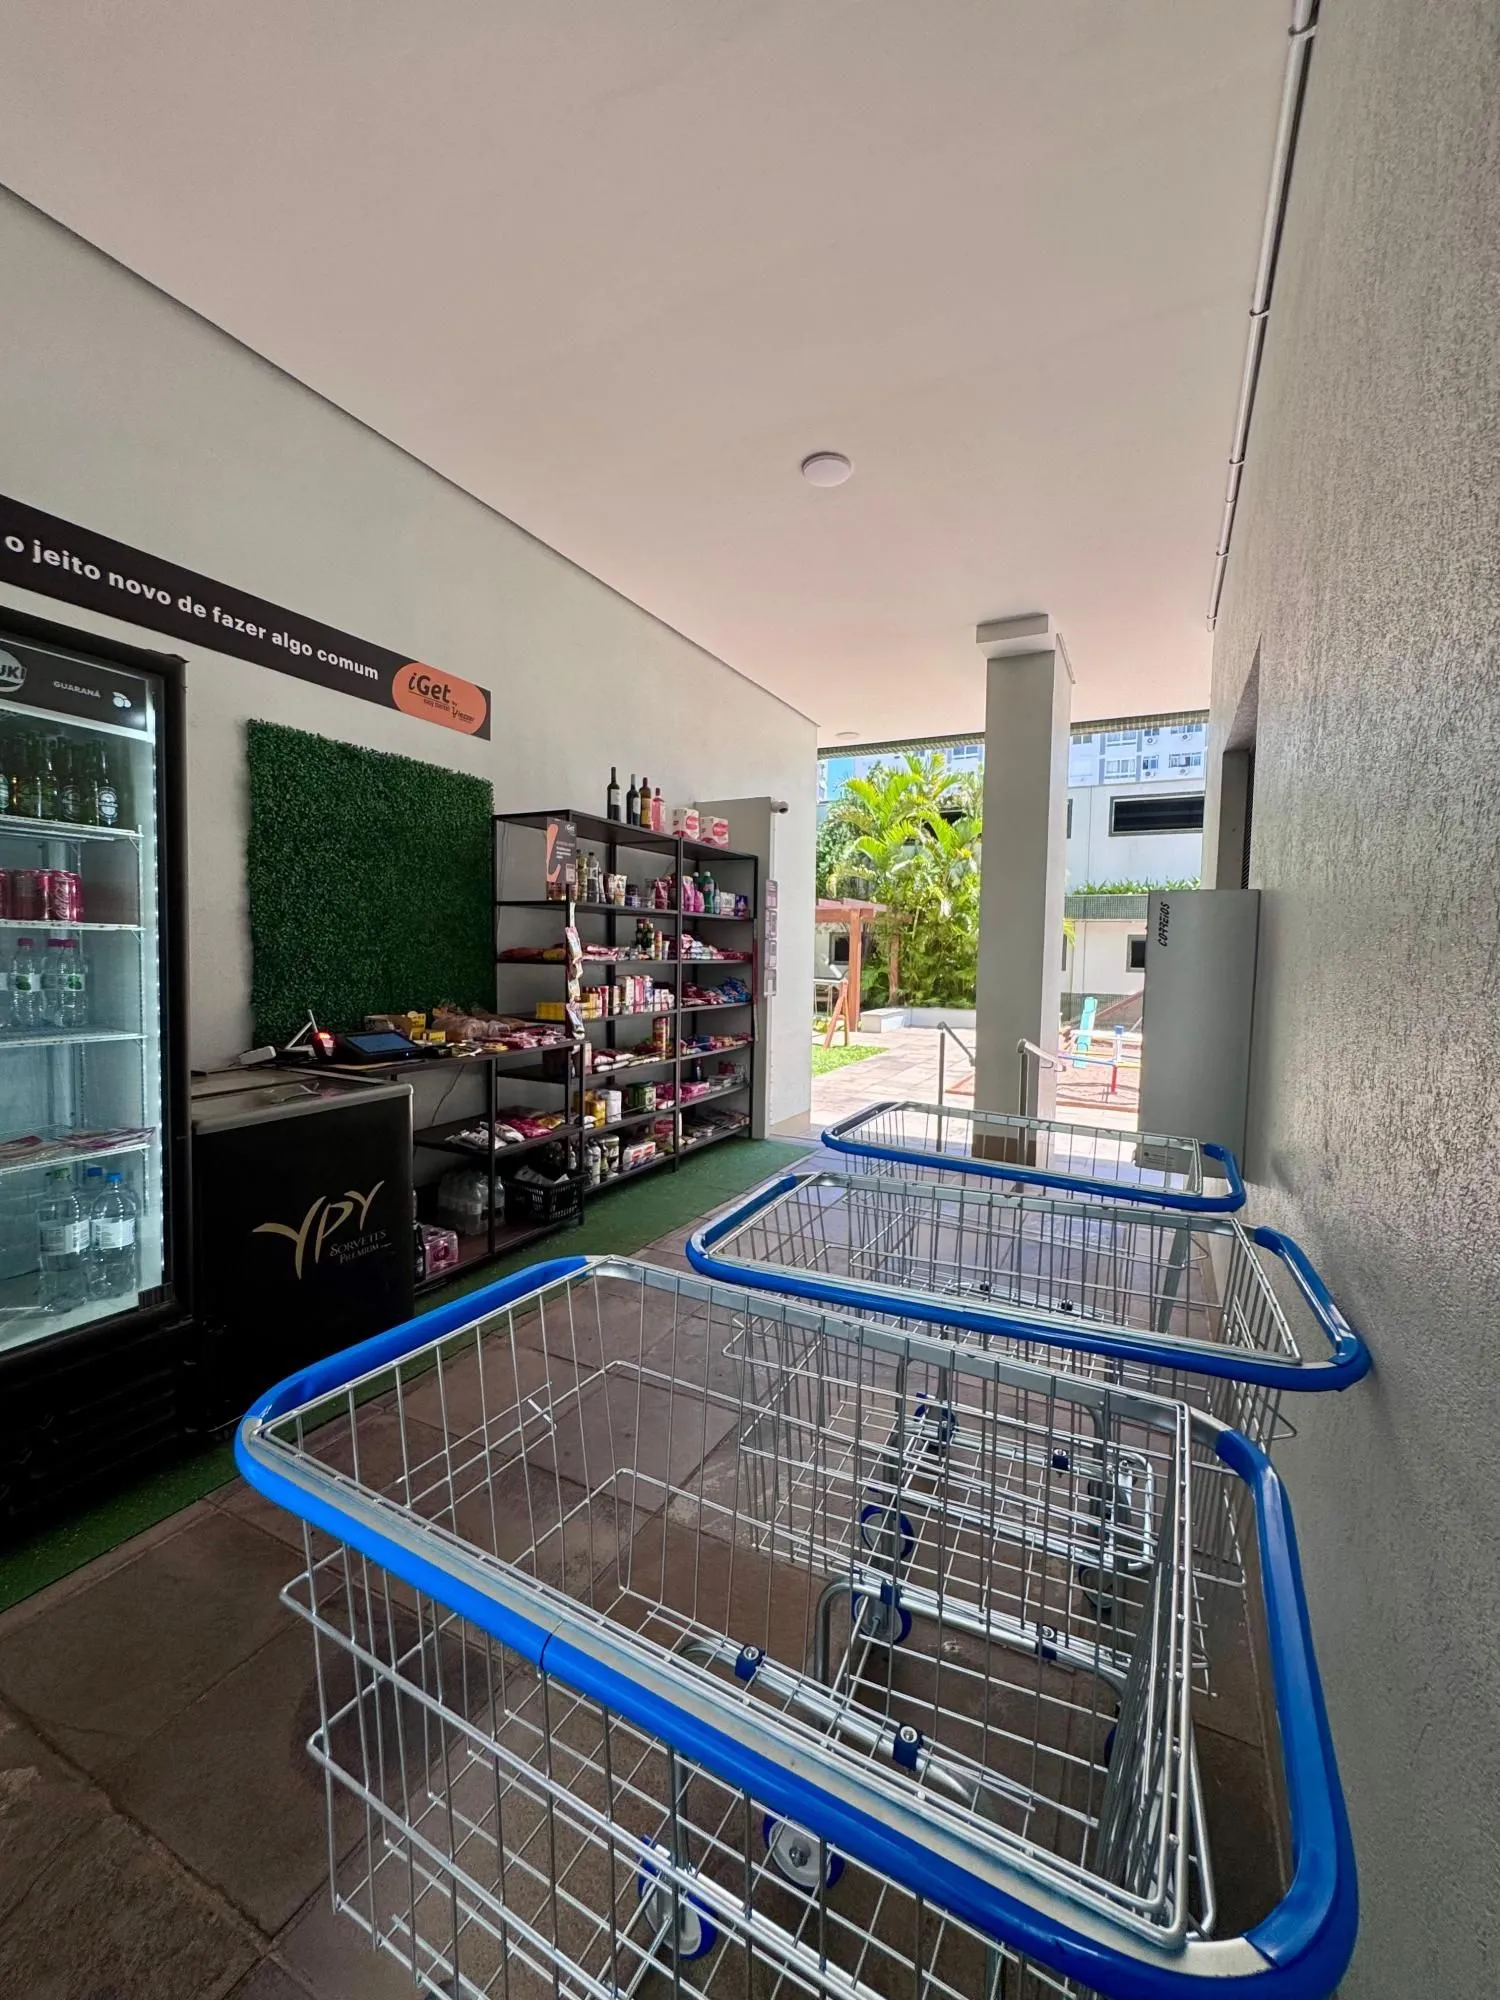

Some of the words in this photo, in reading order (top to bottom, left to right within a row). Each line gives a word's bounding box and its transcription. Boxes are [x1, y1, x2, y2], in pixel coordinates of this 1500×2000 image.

[5, 535, 25, 553] o
[32, 539, 101, 581] jeito
[108, 571, 172, 606] novo
[177, 595, 207, 618] de
[212, 606, 267, 640] fazer
[271, 632, 313, 656] algo
[317, 648, 379, 681] comum
[408, 672, 452, 704] iGet
[1158, 902, 1170, 946] CORREIOS
[251, 1179, 385, 1281] YPY
